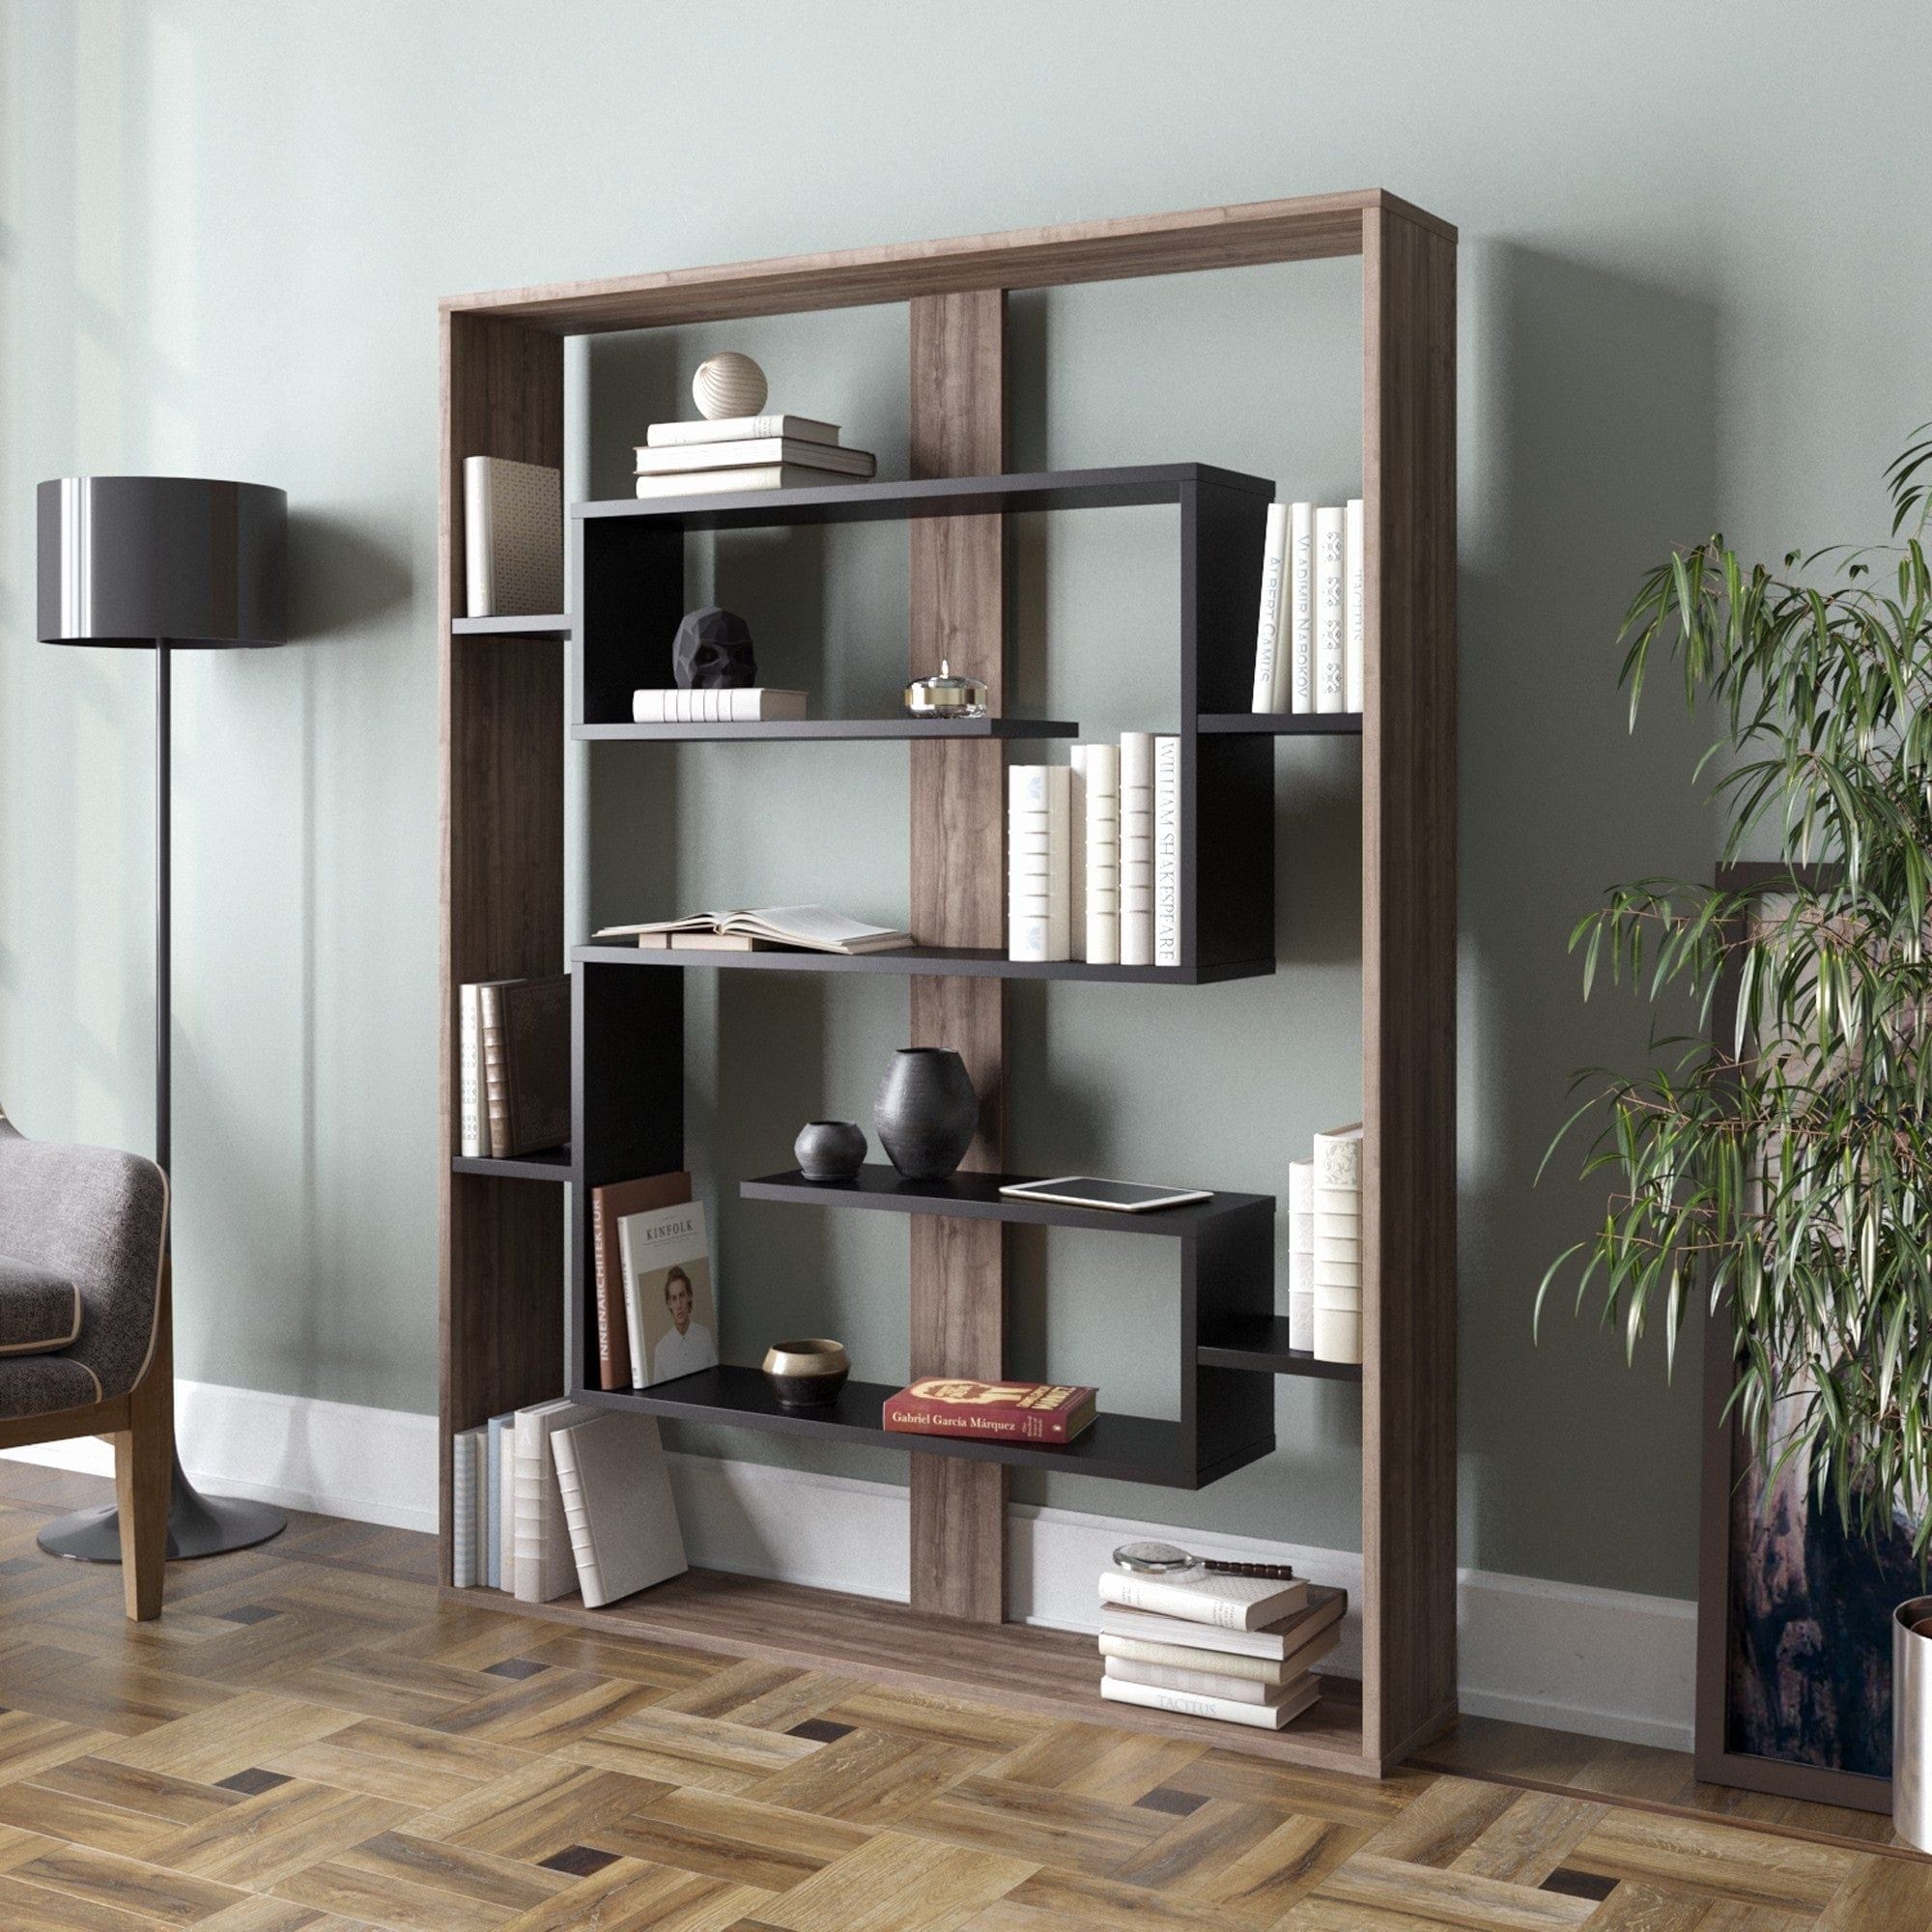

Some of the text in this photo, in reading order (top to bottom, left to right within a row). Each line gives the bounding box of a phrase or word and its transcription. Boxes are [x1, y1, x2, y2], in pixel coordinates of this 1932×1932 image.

[1260, 555, 1281, 682] ALBERT CAMUS
[1297, 534, 1310, 697] VLADIMIR NABOKOV
[1159, 742, 1175, 960] WILLIAM SHAKESPEARE
[592, 1199, 610, 1361] INNENARCHITEKTUR
[646, 1220, 695, 1240] KINFOLK
[892, 1411, 929, 1425] Gabriel
[932, 1414, 967, 1427] García
[970, 1416, 1015, 1432] Márquez
[1157, 1694, 1218, 1716] TACITUS
